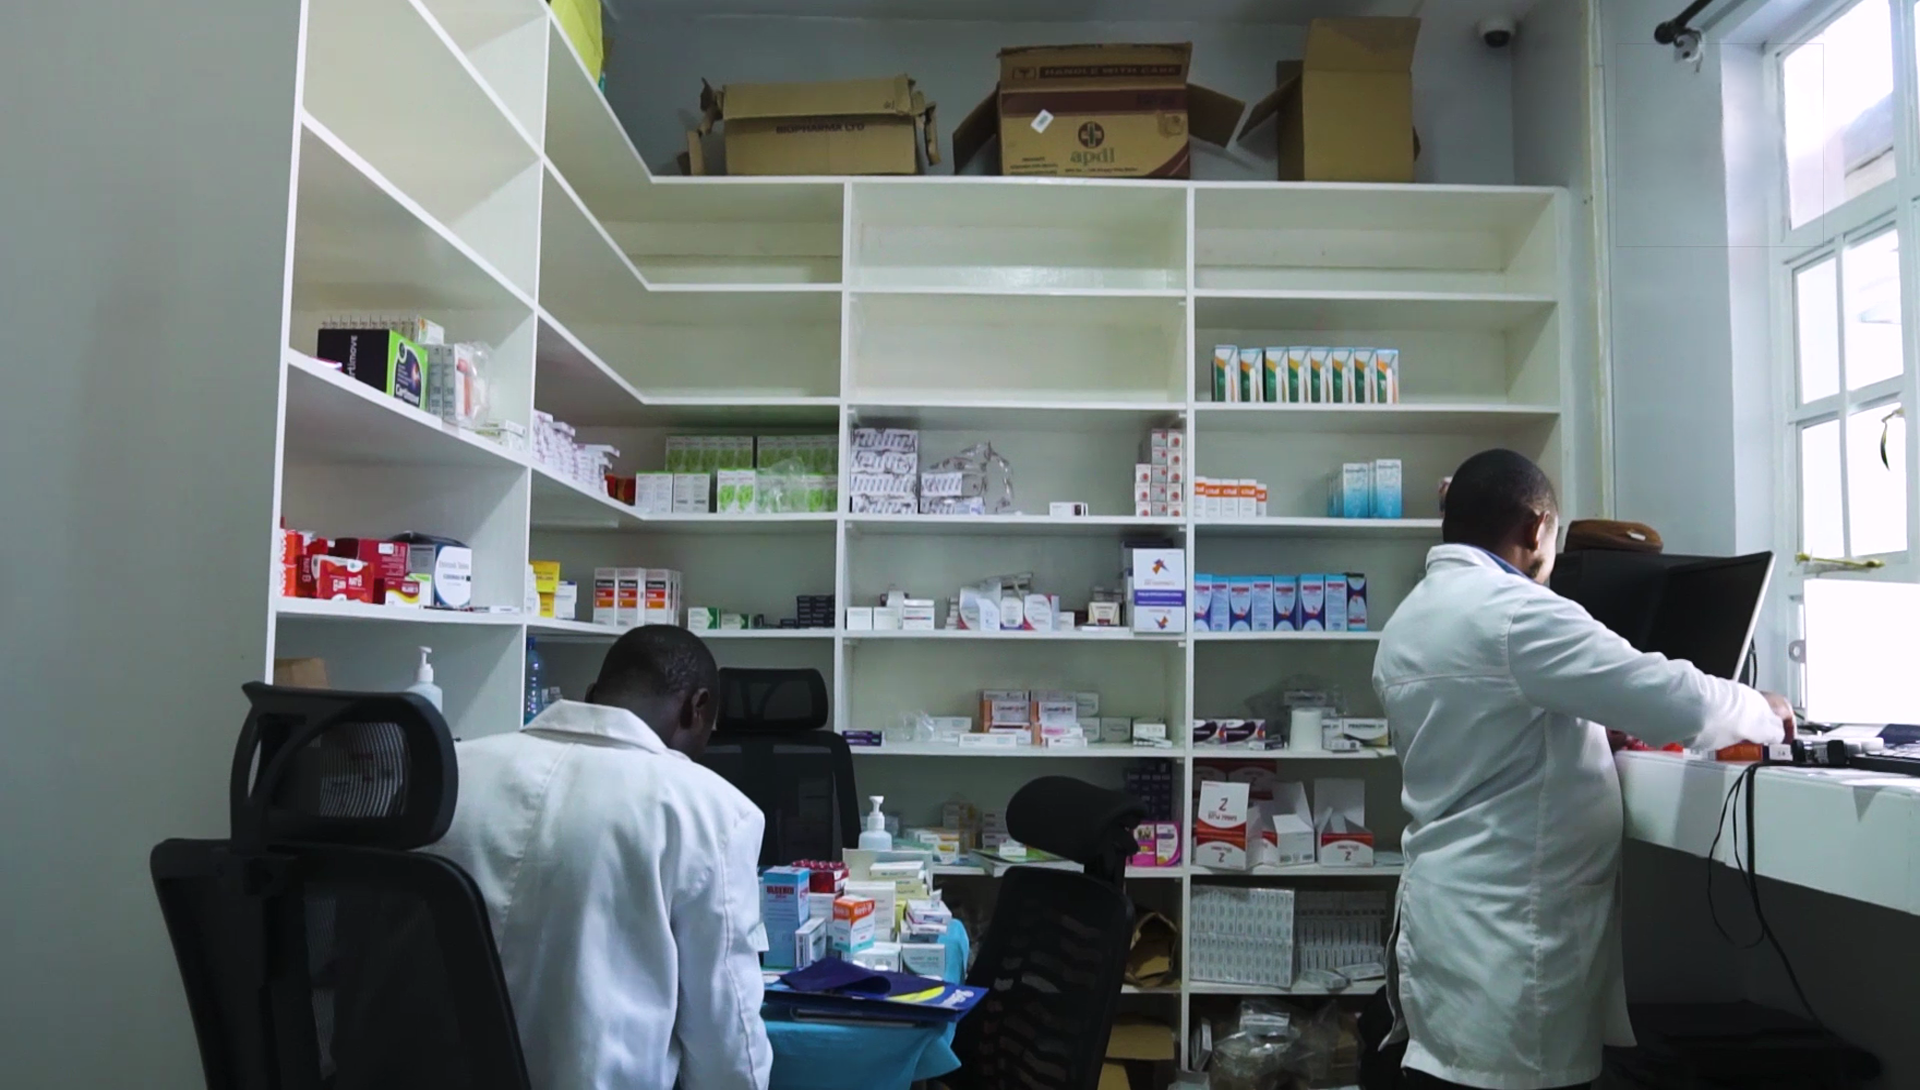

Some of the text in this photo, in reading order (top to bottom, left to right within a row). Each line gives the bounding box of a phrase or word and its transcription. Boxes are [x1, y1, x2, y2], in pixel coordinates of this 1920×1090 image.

[1044, 65, 1177, 77] HANDLE WITH CARE
[776, 122, 865, 134] BIOPHARMA LTD
